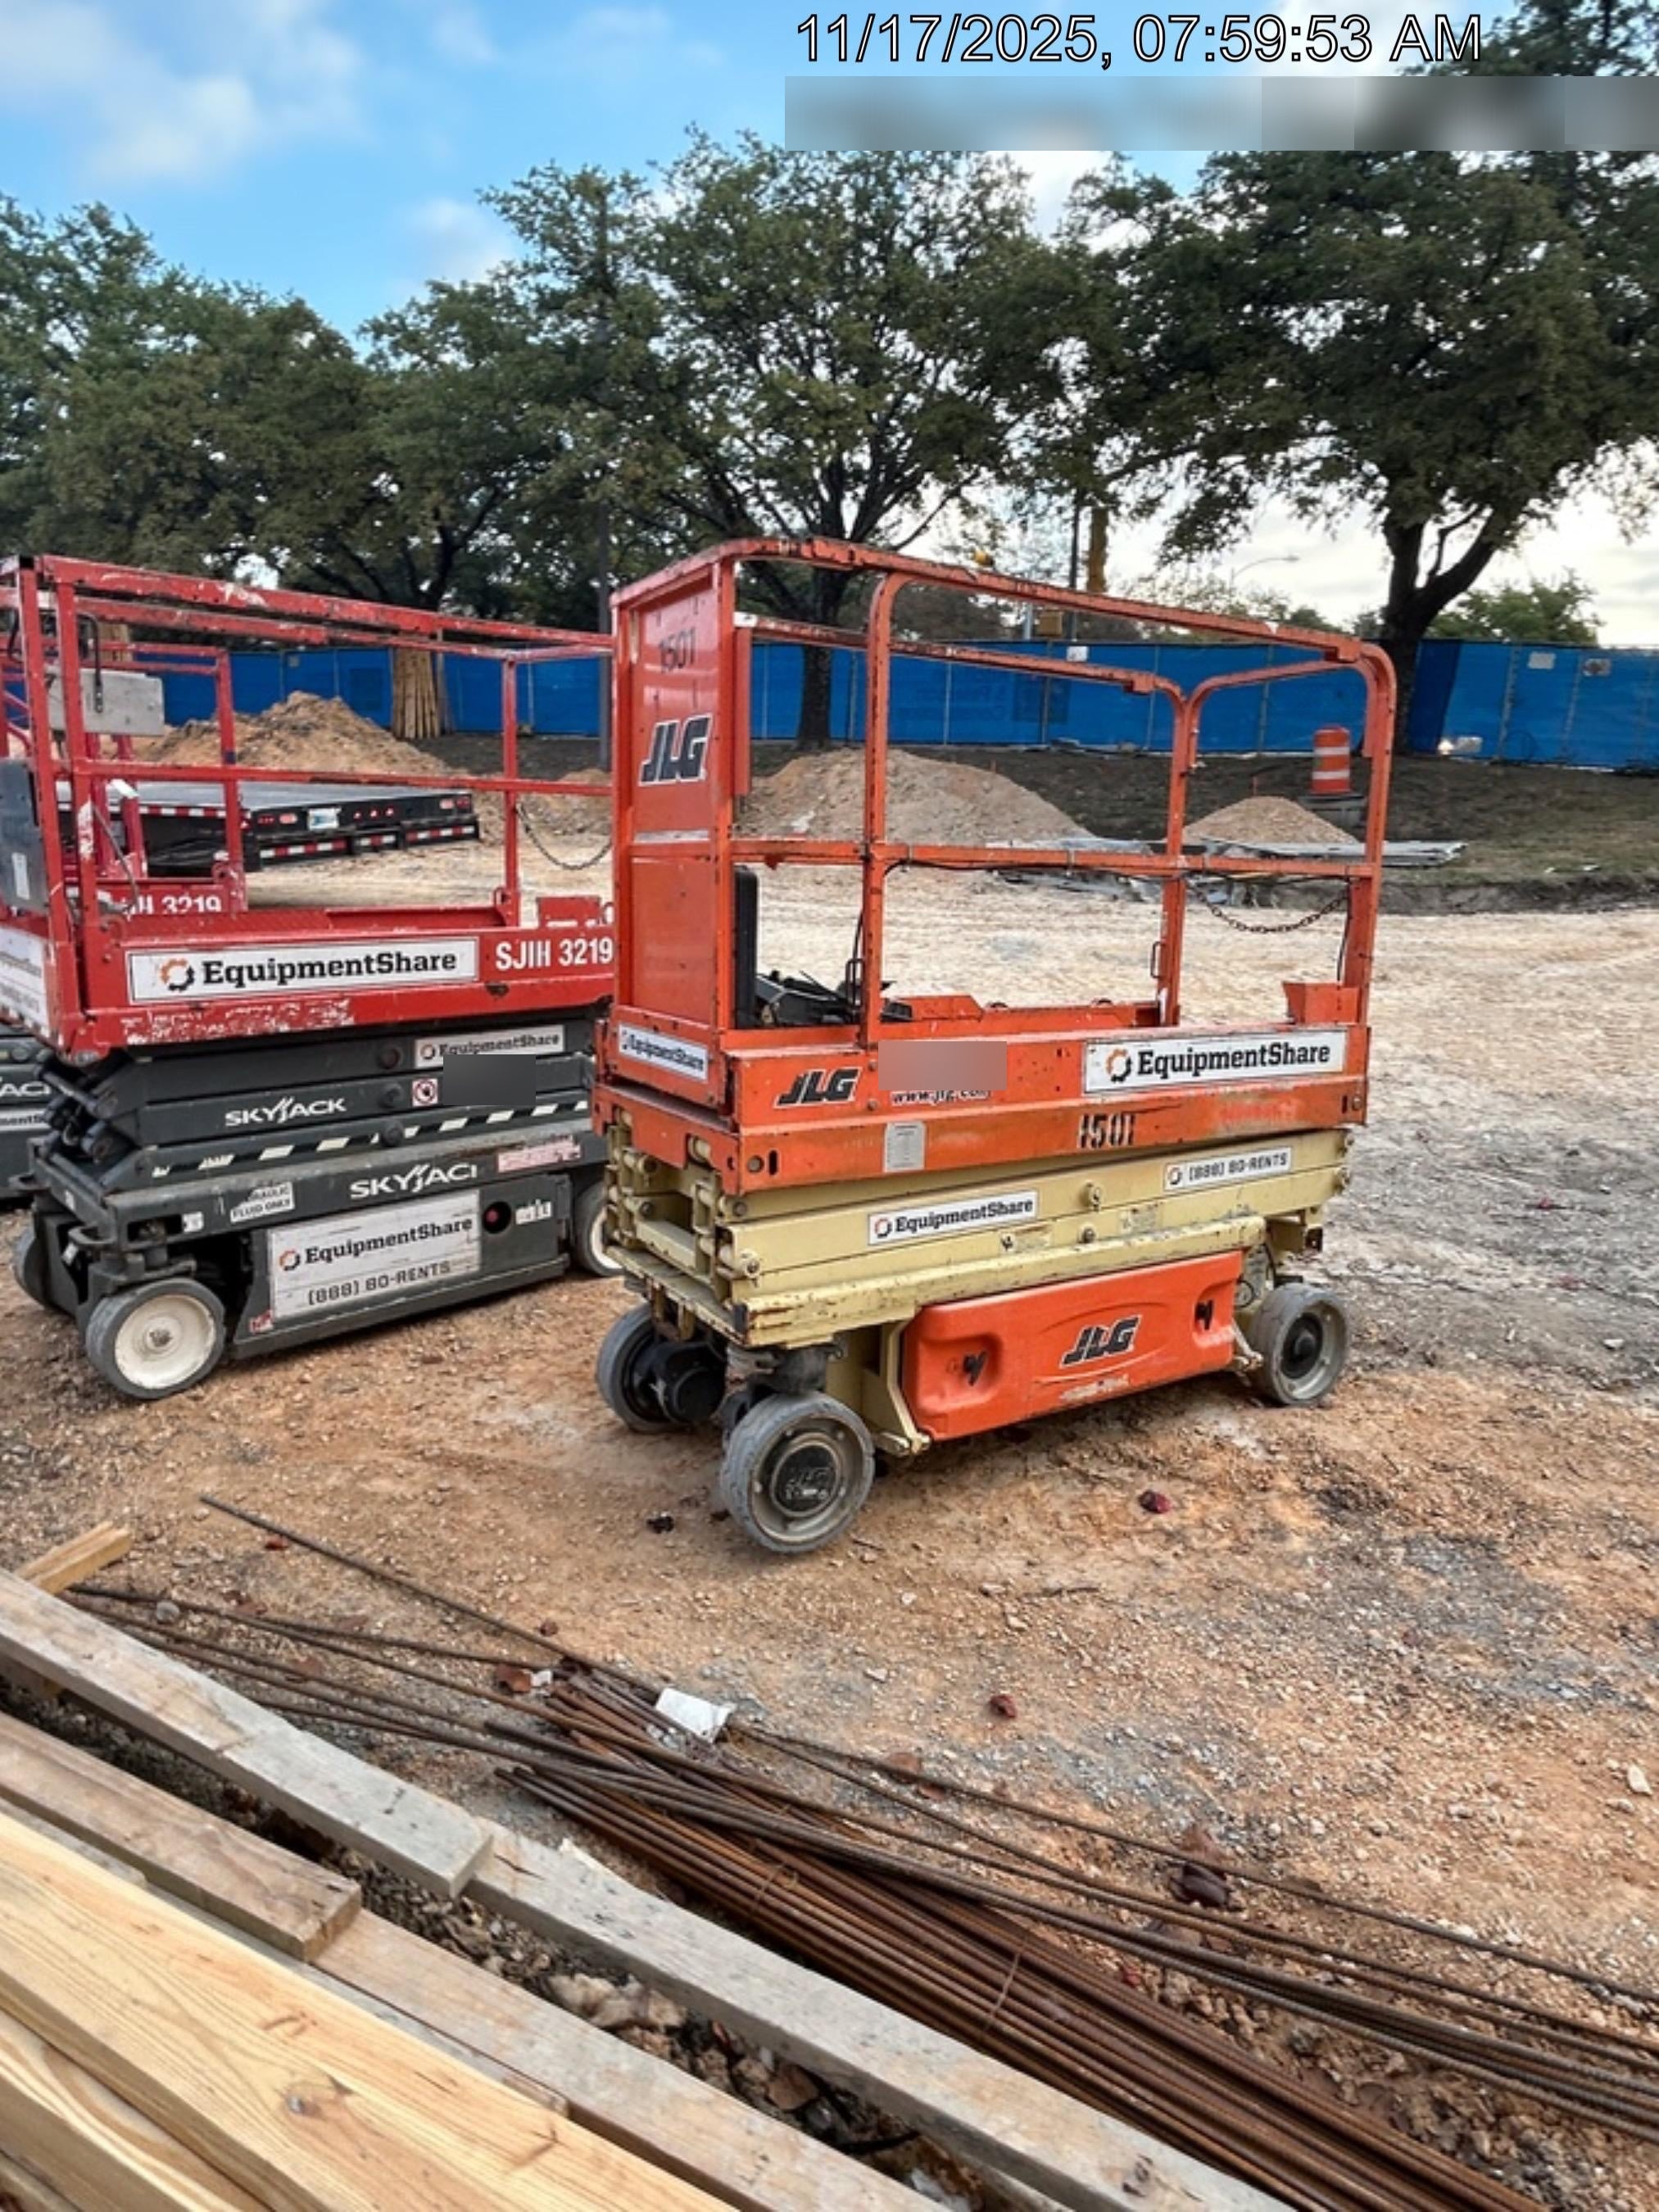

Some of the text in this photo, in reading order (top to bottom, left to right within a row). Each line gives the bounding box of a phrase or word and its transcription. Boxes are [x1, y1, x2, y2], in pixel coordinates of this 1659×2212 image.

[640, 714, 712, 783] JLG
[202, 951, 457, 988] EquipmentShare
[558, 936, 614, 967] 3219
[1138, 1041, 1330, 1081] EquipmentShare
[776, 1067, 860, 1106] JLG
[224, 1095, 347, 1127] SKYJACK
[1080, 1113, 1135, 1149] 1501
[895, 1199, 1033, 1233] EquipmentShare
[305, 1218, 473, 1262] EquipmentShare
[1061, 1315, 1142, 1367] JLG
